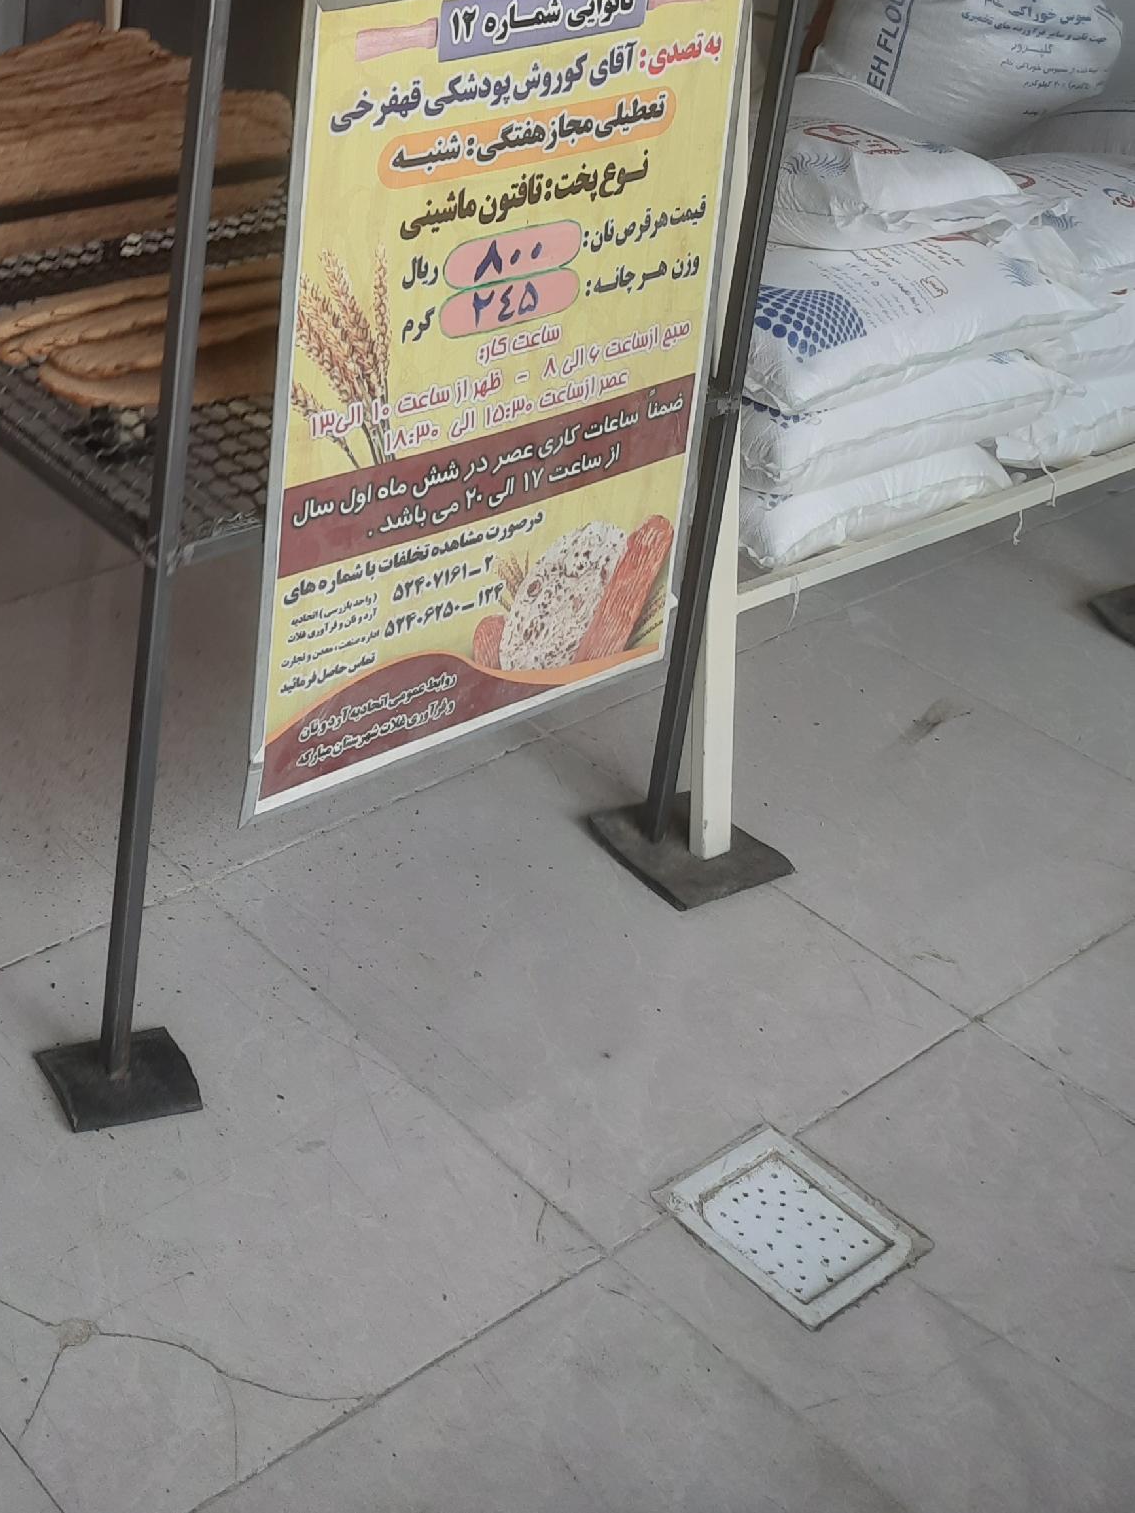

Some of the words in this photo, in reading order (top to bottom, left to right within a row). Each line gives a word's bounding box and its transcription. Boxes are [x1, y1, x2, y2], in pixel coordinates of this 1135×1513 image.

[450, 9, 478, 43] ۱۲
[1008, 5, 1058, 24] خوراکی
[1059, 12, 1092, 26] سبوس
[590, 41, 637, 87] آقای
[705, 36, 723, 64] به
[513, 53, 589, 100] کوروش
[595, 95, 666, 138] تعطیلی
[545, 112, 594, 150] مجاز
[391, 134, 461, 171] شنبه
[598, 148, 650, 197] نوع
[478, 170, 543, 225] تافتون
[669, 194, 707, 226] قیمت
[400, 188, 477, 240] ماشینی
[615, 207, 652, 247] قرص
[649, 211, 668, 239] هر
[402, 255, 440, 289] ریال
[473, 239, 543, 283] ۸۰۰
[671, 252, 700, 280] وزن
[636, 260, 668, 291] هر
[402, 306, 436, 343] گرم
[663, 321, 691, 348] صبح
[512, 324, 561, 356] ساعت
[543, 357, 557, 378] ۸
[562, 346, 585, 376] الی
[456, 379, 467, 406] از
[474, 370, 502, 400] ظهر
[599, 371, 629, 396] عصر
[373, 399, 391, 422] ۱۰
[397, 387, 451, 415] ساعت
[483, 397, 534, 429] ۱۵:۳۰
[646, 387, 685, 420] ضمناً
[449, 409, 476, 440] الی
[583, 408, 640, 443] ساعات
[384, 422, 441, 456] ۱۸:۳۰
[538, 426, 581, 461] کاری
[464, 453, 488, 484] در
[491, 441, 535, 475] عصر
[548, 454, 602, 482] ساعت
[605, 443, 622, 470] از
[377, 476, 409, 502] ماه
[412, 457, 461, 499] شش
[522, 468, 545, 493] ۱۷
[339, 481, 374, 517] اول
[464, 489, 483, 511] ۲۰
[487, 477, 516, 510] الی
[293, 491, 336, 528] سال
[432, 499, 461, 526] می
[430, 530, 484, 558] مشاهده
[365, 560, 377, 578] با
[377, 543, 429, 574] تخلفات
[282, 578, 319, 606] های
[317, 563, 364, 596] شماره
[290, 611, 319, 626] اتحادیه
[344, 614, 357, 629] نان
[362, 607, 378, 622] آرد
[287, 629, 307, 644] غلات
[280, 652, 306, 669] تجارت
[316, 663, 348, 685] حاصل
[347, 651, 376, 674] تماس
[426, 672, 457, 692] روابط
[350, 693, 389, 721] اتحادیه
[388, 683, 427, 710] عمومی
[299, 718, 320, 742] نان
[327, 705, 351, 730] آرد
[379, 713, 408, 736] غلات
[333, 723, 380, 755] شهرستان
[296, 743, 334, 767] مبارکه
